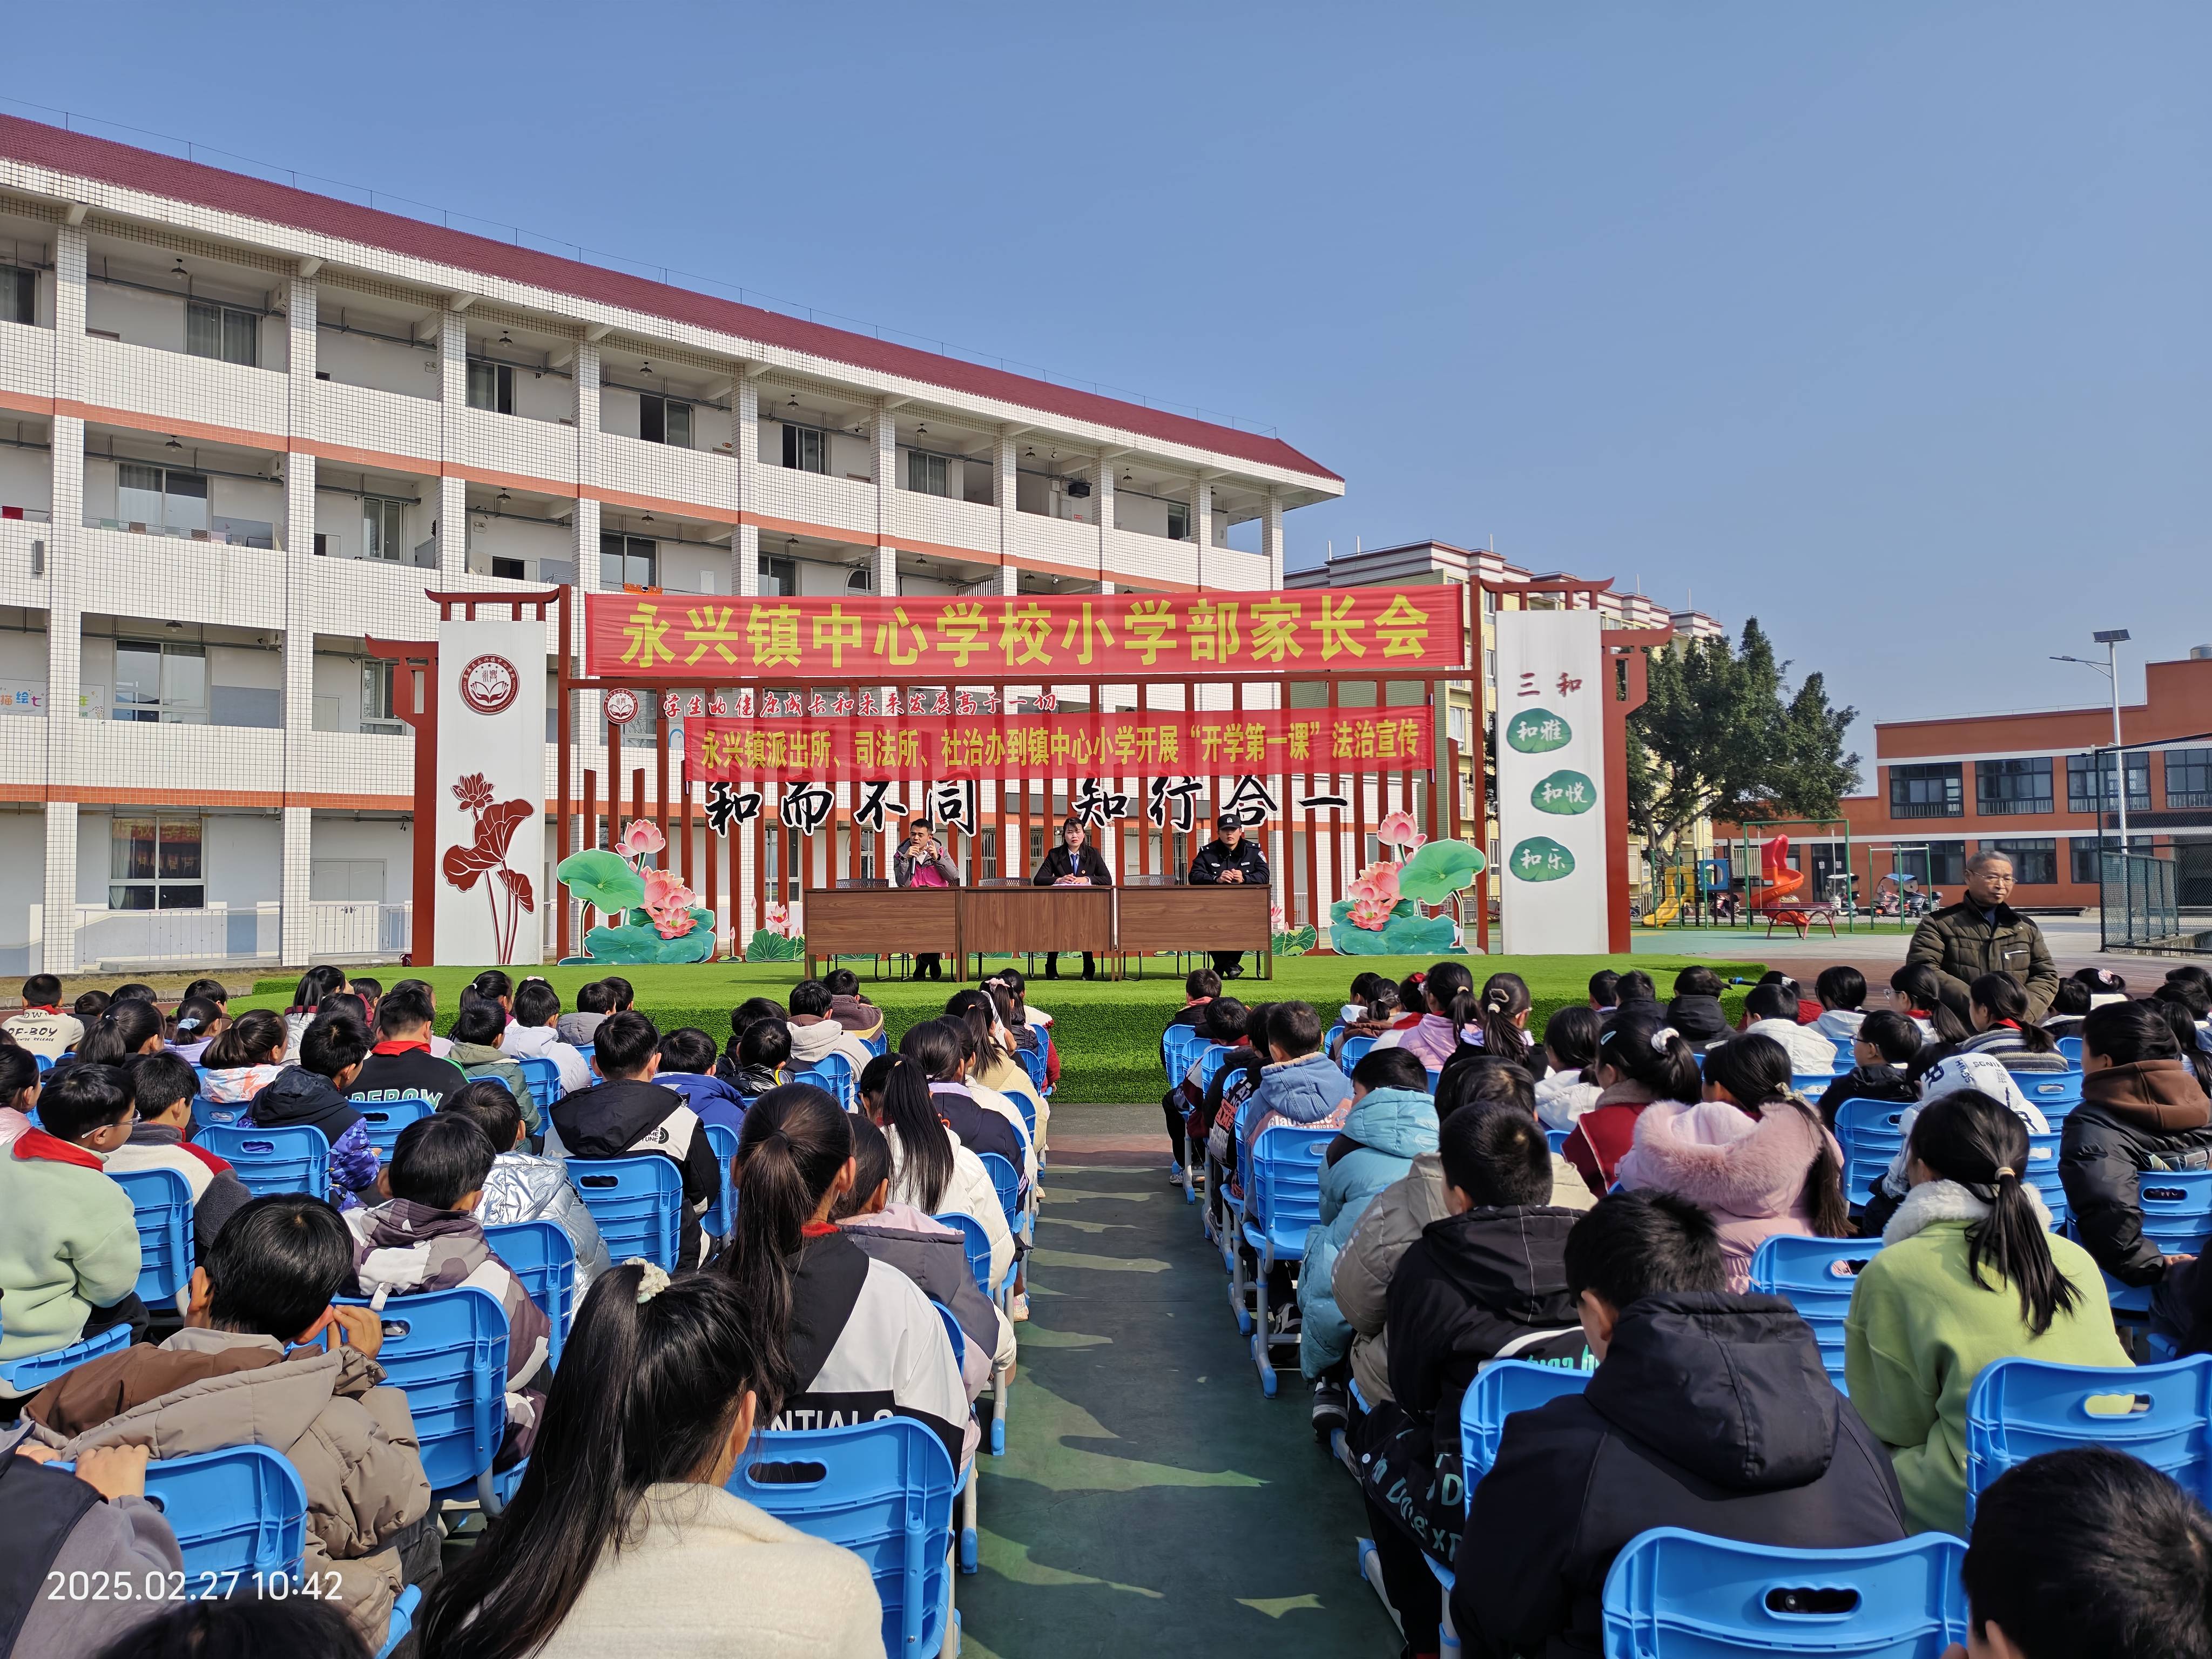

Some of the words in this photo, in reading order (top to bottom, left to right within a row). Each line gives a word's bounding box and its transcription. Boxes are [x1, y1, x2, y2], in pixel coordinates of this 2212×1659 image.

[619, 594, 1430, 668] 永兴镇中心学校小学部家长会
[1517, 672, 1583, 698] 三和
[664, 691, 1058, 718] 学生的健康成长和未来发展高于一切
[1516, 719, 1563, 743] 和雅
[704, 772, 977, 838] 和而不同
[1071, 770, 1349, 833] 知行合一
[1541, 782, 1588, 804] 和悦
[1520, 848, 1566, 870] 和乐
